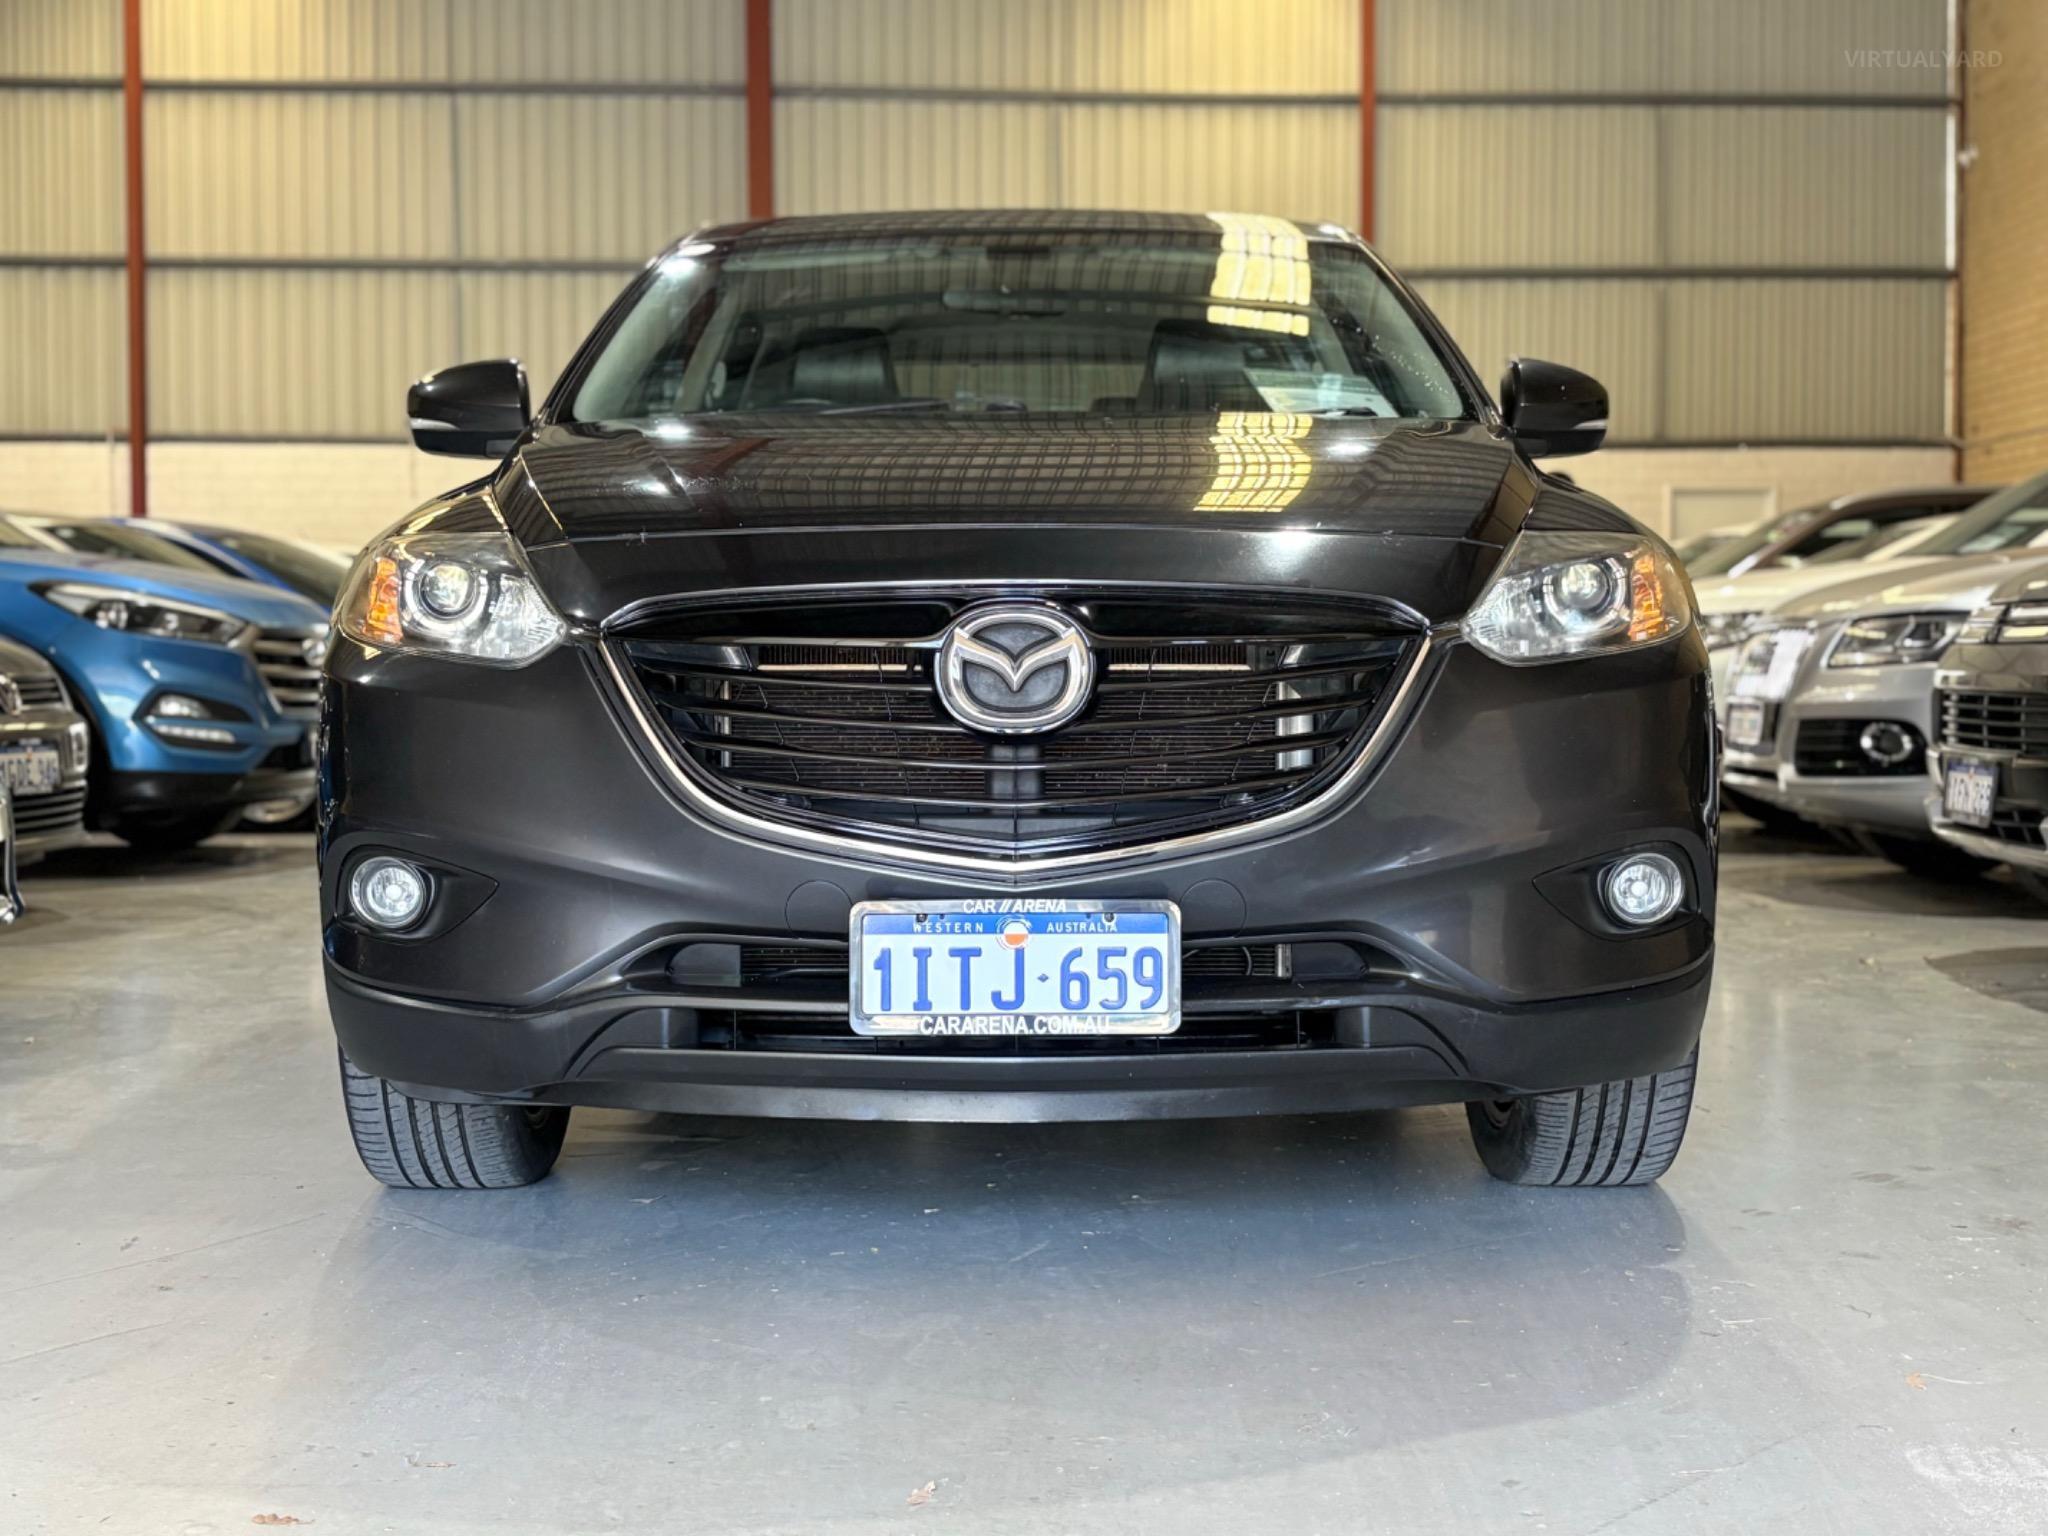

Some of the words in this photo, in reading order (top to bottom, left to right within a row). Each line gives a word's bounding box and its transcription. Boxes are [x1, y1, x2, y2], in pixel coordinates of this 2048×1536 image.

[963, 899, 996, 913] CAR
[913, 922, 983, 933] WESTERN
[1047, 922, 1118, 933] AUSTRALIA
[920, 1015, 1109, 1035] CARARENA.COM.AU
